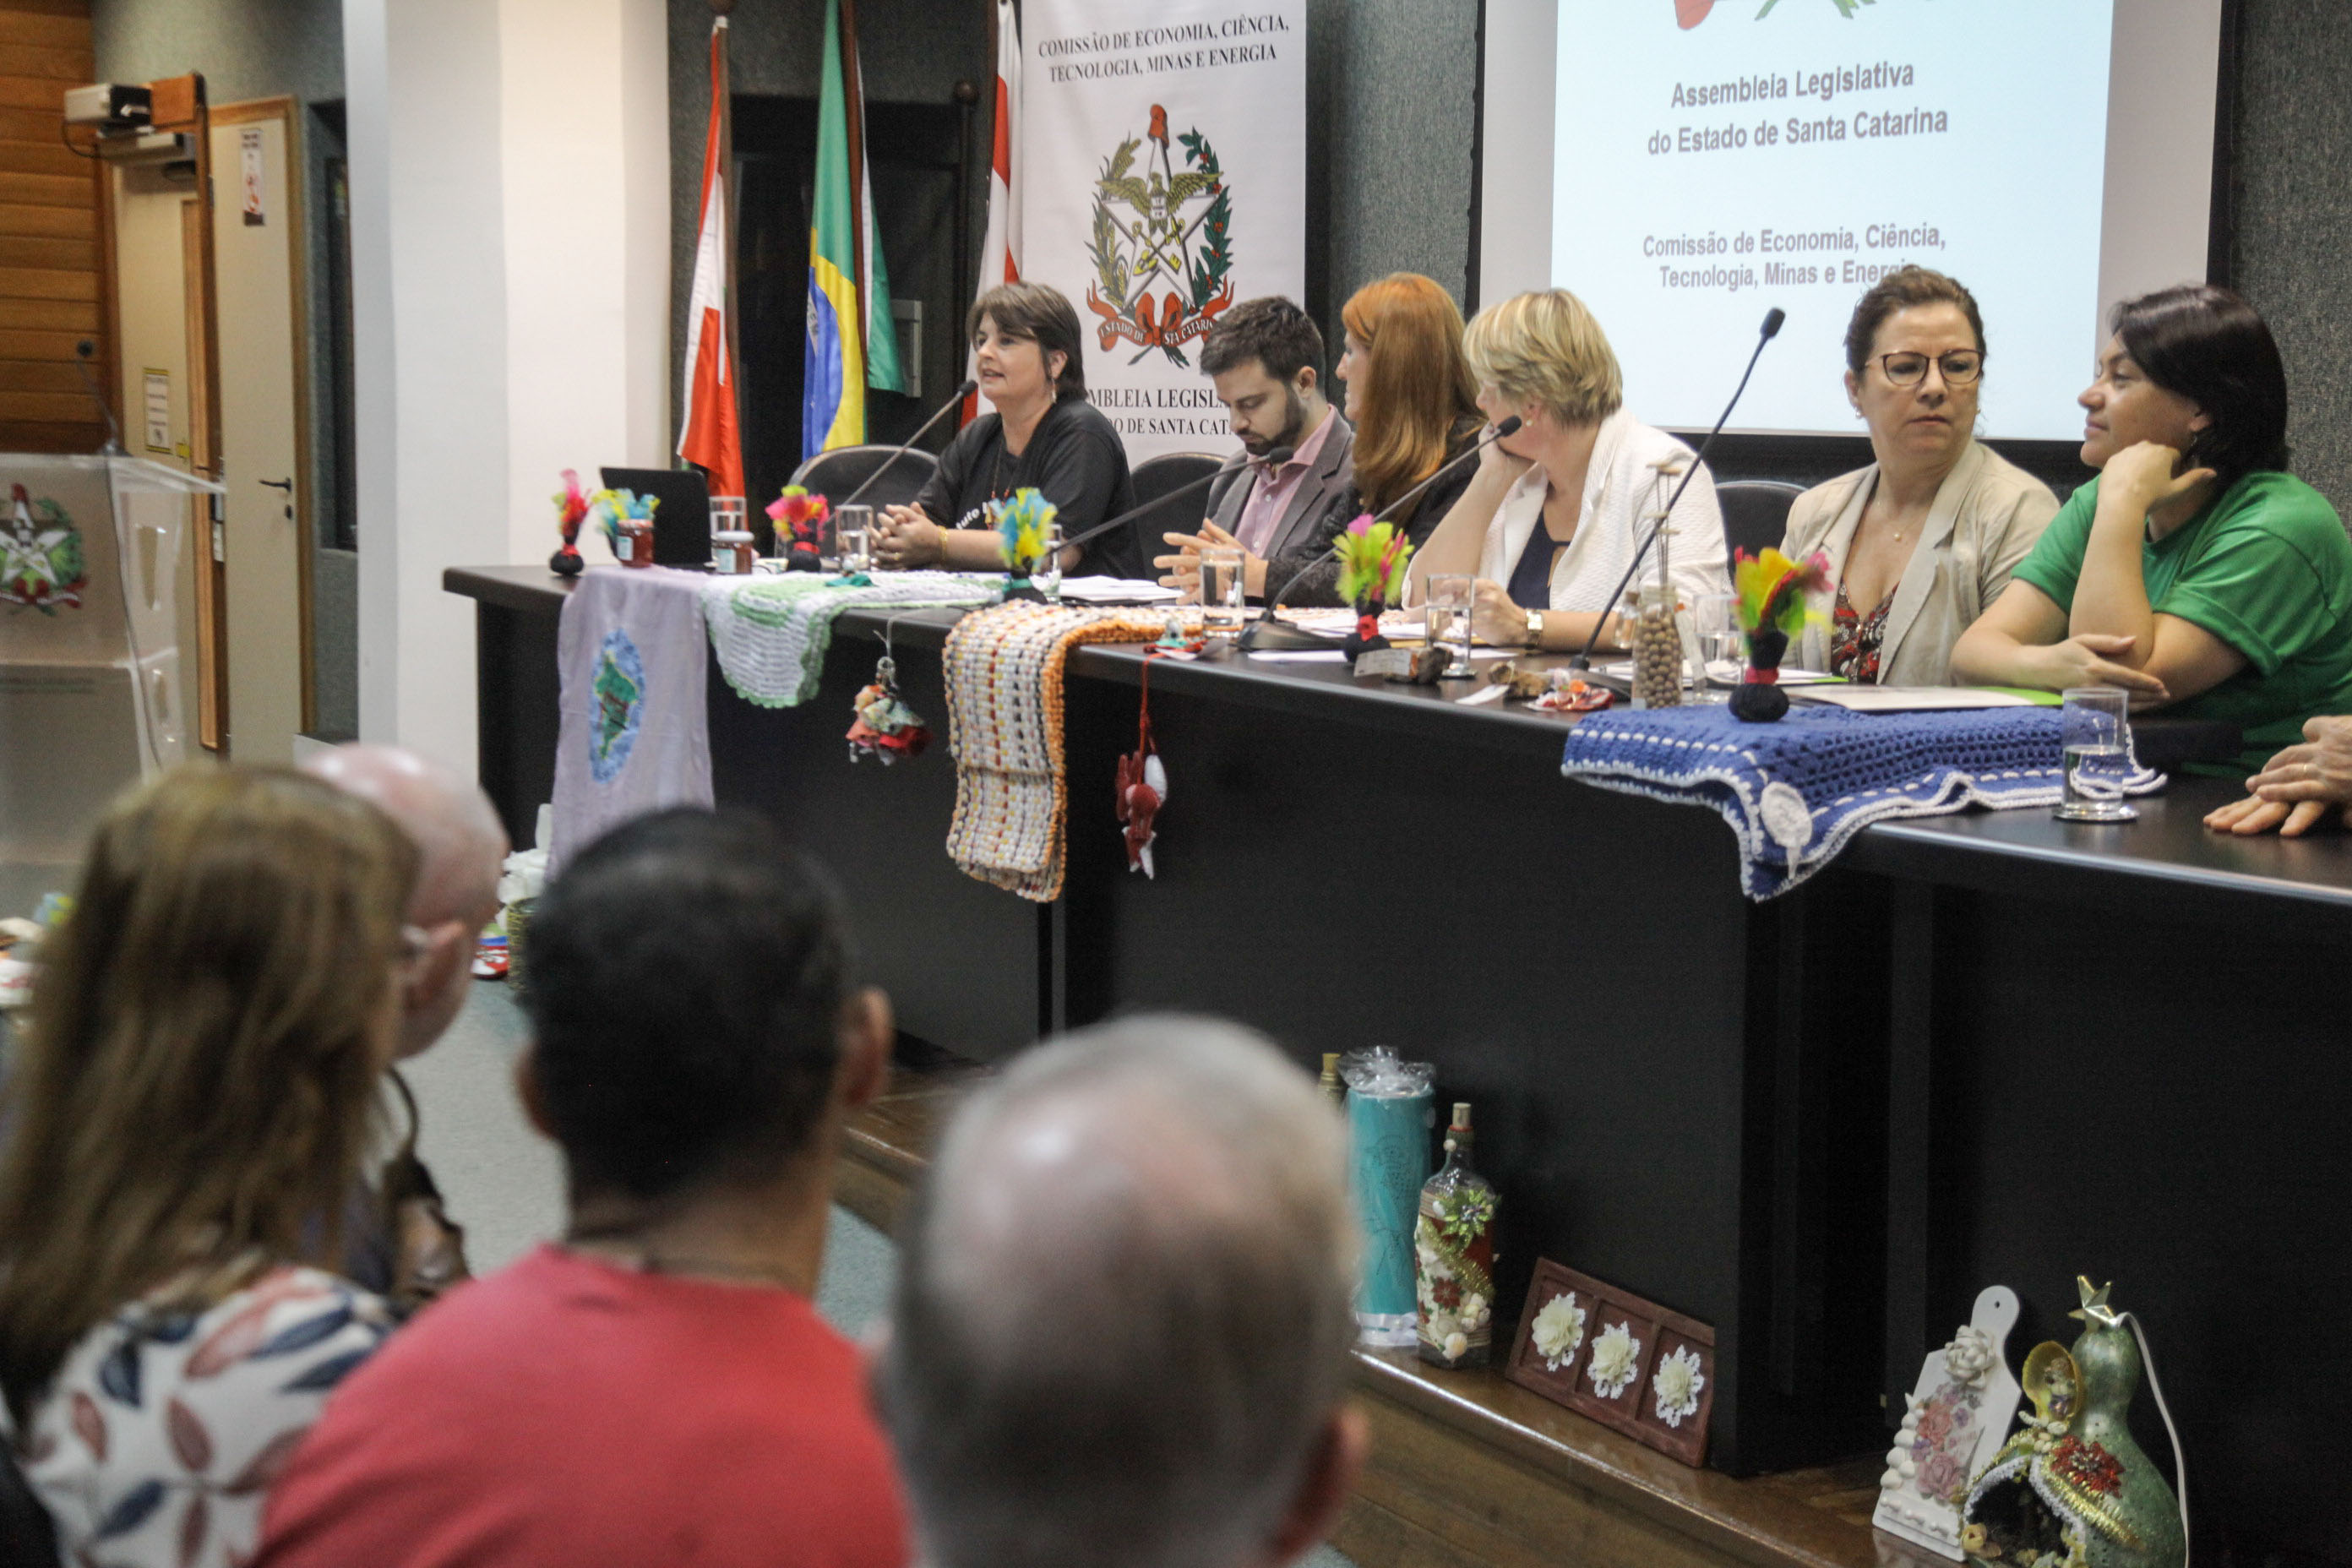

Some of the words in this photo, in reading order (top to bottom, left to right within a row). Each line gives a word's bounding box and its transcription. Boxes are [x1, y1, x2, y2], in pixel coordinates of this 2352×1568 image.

[1038, 32, 1109, 57] COMISSÃO
[1113, 32, 1131, 49] DE
[1135, 23, 1218, 47] ECONOMIA,
[1222, 14, 1289, 37] CIÊNCIA,
[1049, 57, 1143, 83] TECNOLOGIA,
[1146, 52, 1192, 73] MINAS
[1196, 51, 1204, 67] E
[1210, 43, 1277, 66] ENERGIA
[1671, 73, 1787, 108] Assembleia
[1796, 61, 1914, 101] Legislativa
[1647, 129, 1671, 155] do
[1678, 122, 1747, 152] Estado
[1754, 120, 1778, 146] de
[1786, 115, 1846, 144] Santa
[1854, 106, 1947, 138] Catarina
[1643, 231, 1728, 257] Comissão
[1734, 231, 1755, 253] de
[1761, 226, 1859, 253] Economia,
[1865, 222, 1946, 251] Ciência,
[1660, 264, 1758, 291] Tecnologia,
[1764, 262, 1817, 285] Minas
[1825, 266, 1836, 284] e
[1088, 388, 1152, 407] MBLEIA
[1157, 388, 1222, 409] LEGISL
[1127, 417, 1146, 434] DE
[1148, 417, 1195, 435] SANTA
[1199, 418, 1231, 435] CAT
